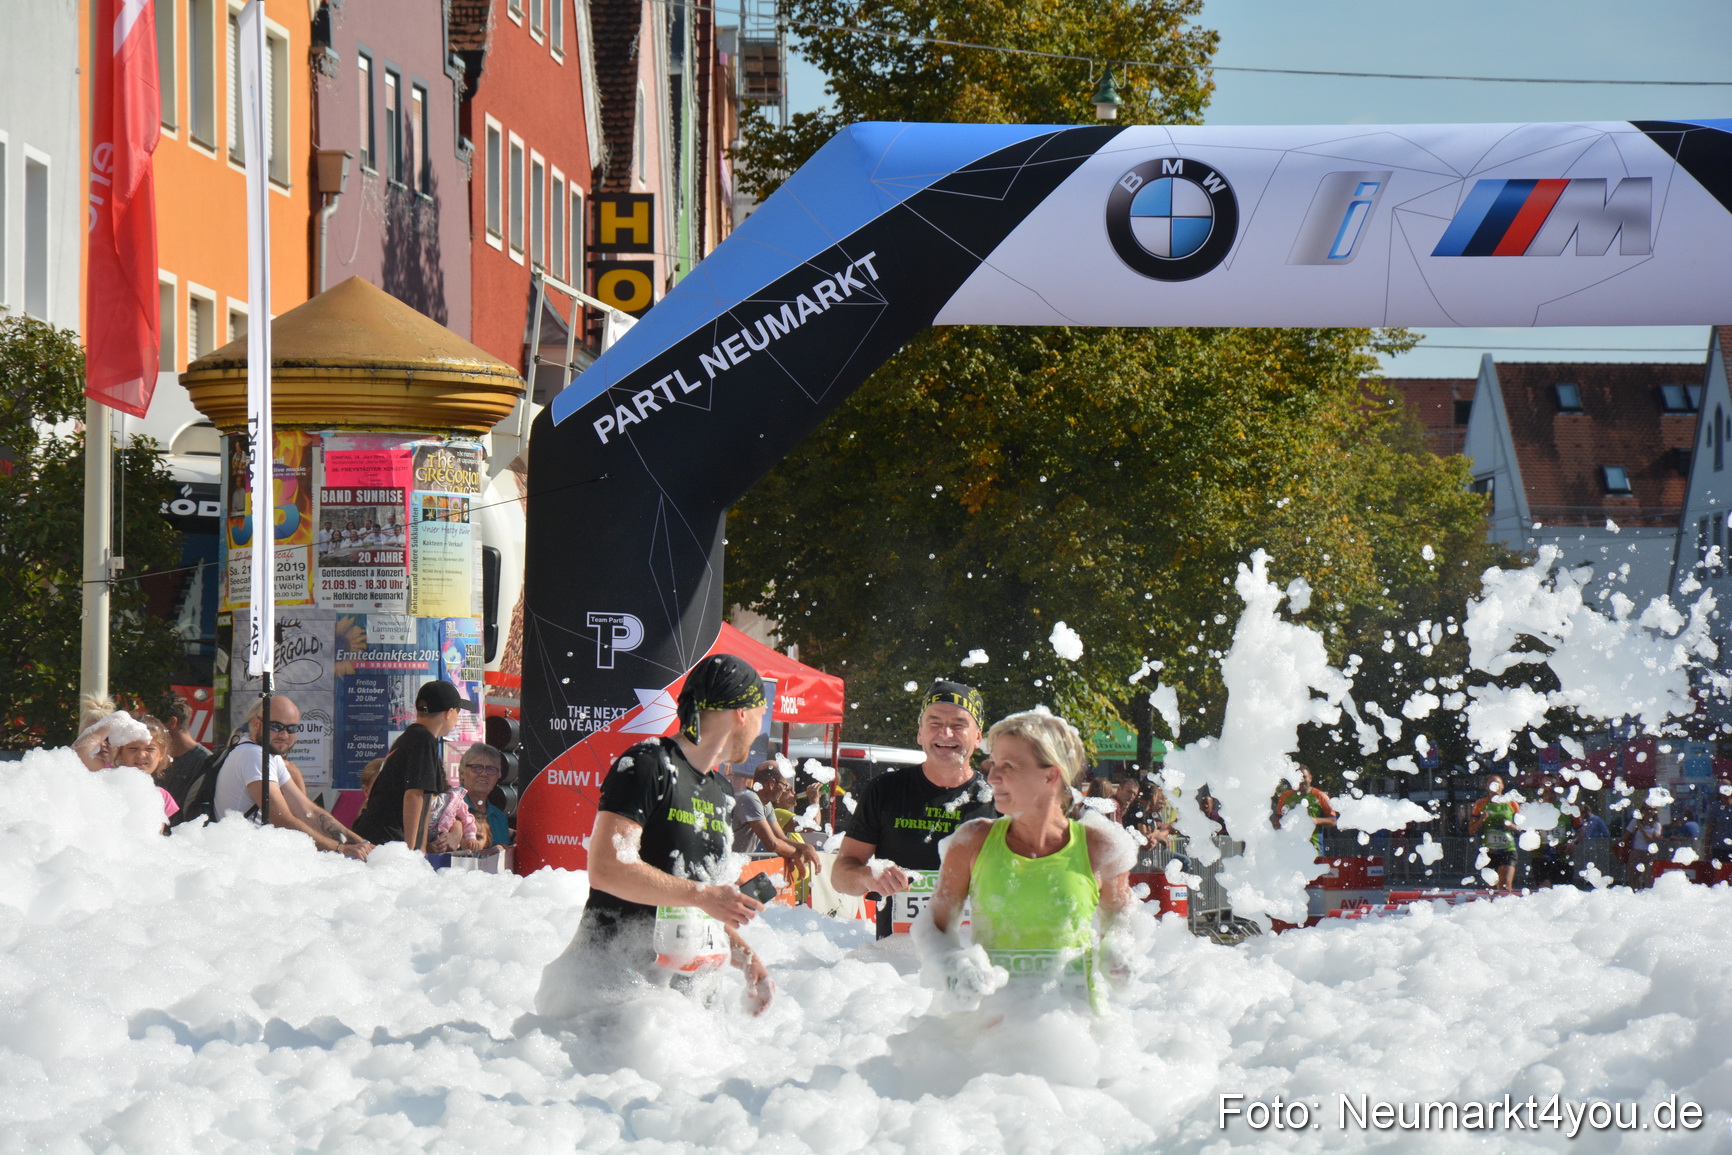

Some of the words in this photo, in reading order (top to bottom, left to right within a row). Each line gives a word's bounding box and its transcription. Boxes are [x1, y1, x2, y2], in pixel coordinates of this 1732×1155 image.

[1118, 159, 1227, 194] BMW
[592, 369, 702, 444] PARTL
[698, 251, 880, 380] NEUMARKT
[321, 489, 352, 503] BAND
[356, 489, 403, 503] SUNRISE
[411, 507, 419, 548] Sukkulenten
[358, 552, 370, 563] 20
[374, 552, 403, 563] JAHRE
[411, 549, 419, 571] andere
[230, 567, 239, 576] Sa.
[276, 562, 306, 572] 2019
[322, 568, 369, 577] Gottesdienst
[370, 569, 375, 577] &
[376, 568, 403, 577] Konzert
[322, 580, 356, 590] 21.09.19
[365, 579, 387, 590] 18.30
[389, 579, 403, 590] Uhr
[411, 574, 419, 587] und
[333, 591, 368, 601] Hofkirche
[370, 591, 403, 600] Neumarkt
[411, 588, 419, 614] Kakteen
[336, 649, 417, 662] Erntedankfest
[567, 705, 591, 719] THE
[594, 707, 628, 720] NEXT
[307, 723, 323, 732] Uhr
[549, 718, 567, 731] 100
[569, 719, 611, 732] YEARS
[353, 734, 379, 742] Samstag
[547, 769, 591, 786] BMW
[691, 797, 715, 815] TEAM
[925, 806, 961, 820] TEAM
[667, 808, 710, 830] FORRT
[894, 818, 951, 833] FORREST
